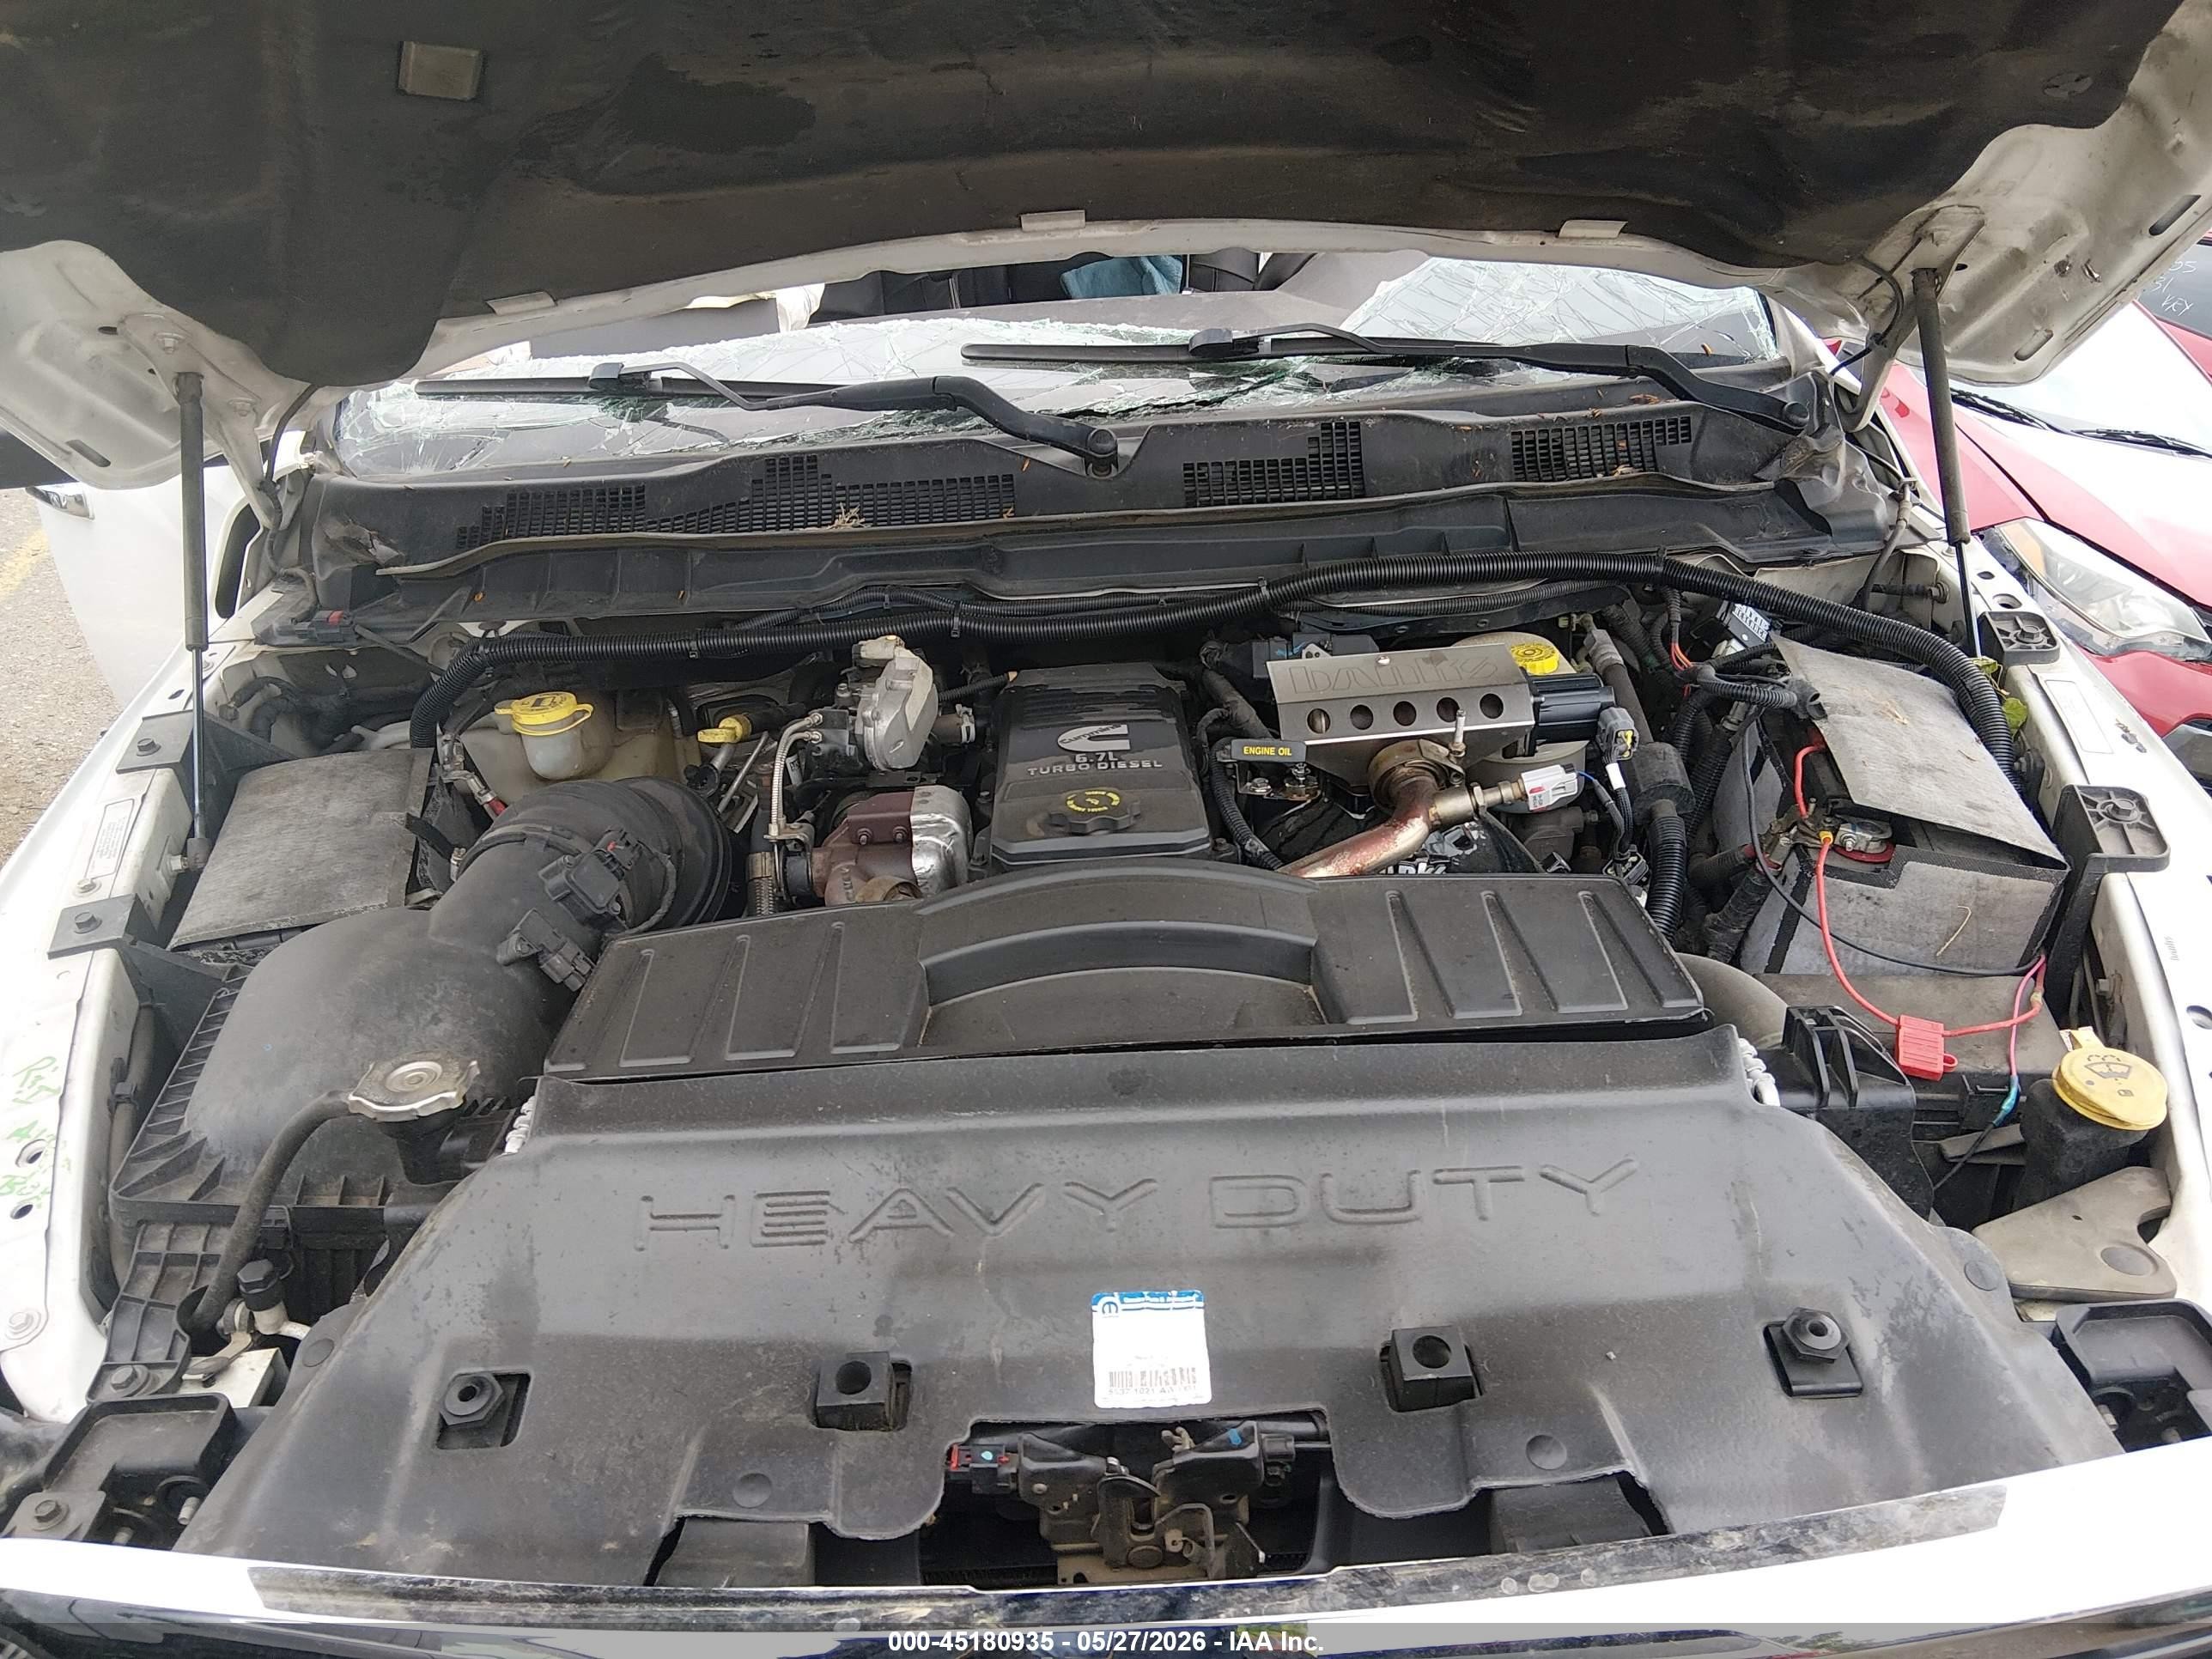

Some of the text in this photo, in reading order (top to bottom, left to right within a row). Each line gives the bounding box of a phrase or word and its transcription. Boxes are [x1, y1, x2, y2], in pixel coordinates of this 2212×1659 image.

[1075, 752, 1119, 763] 6.7L
[1243, 746, 1292, 757] ENGINE OIL
[1028, 760, 1163, 775] TURBO DIESEL
[635, 1158, 1639, 1251] HEAVY DUTY
